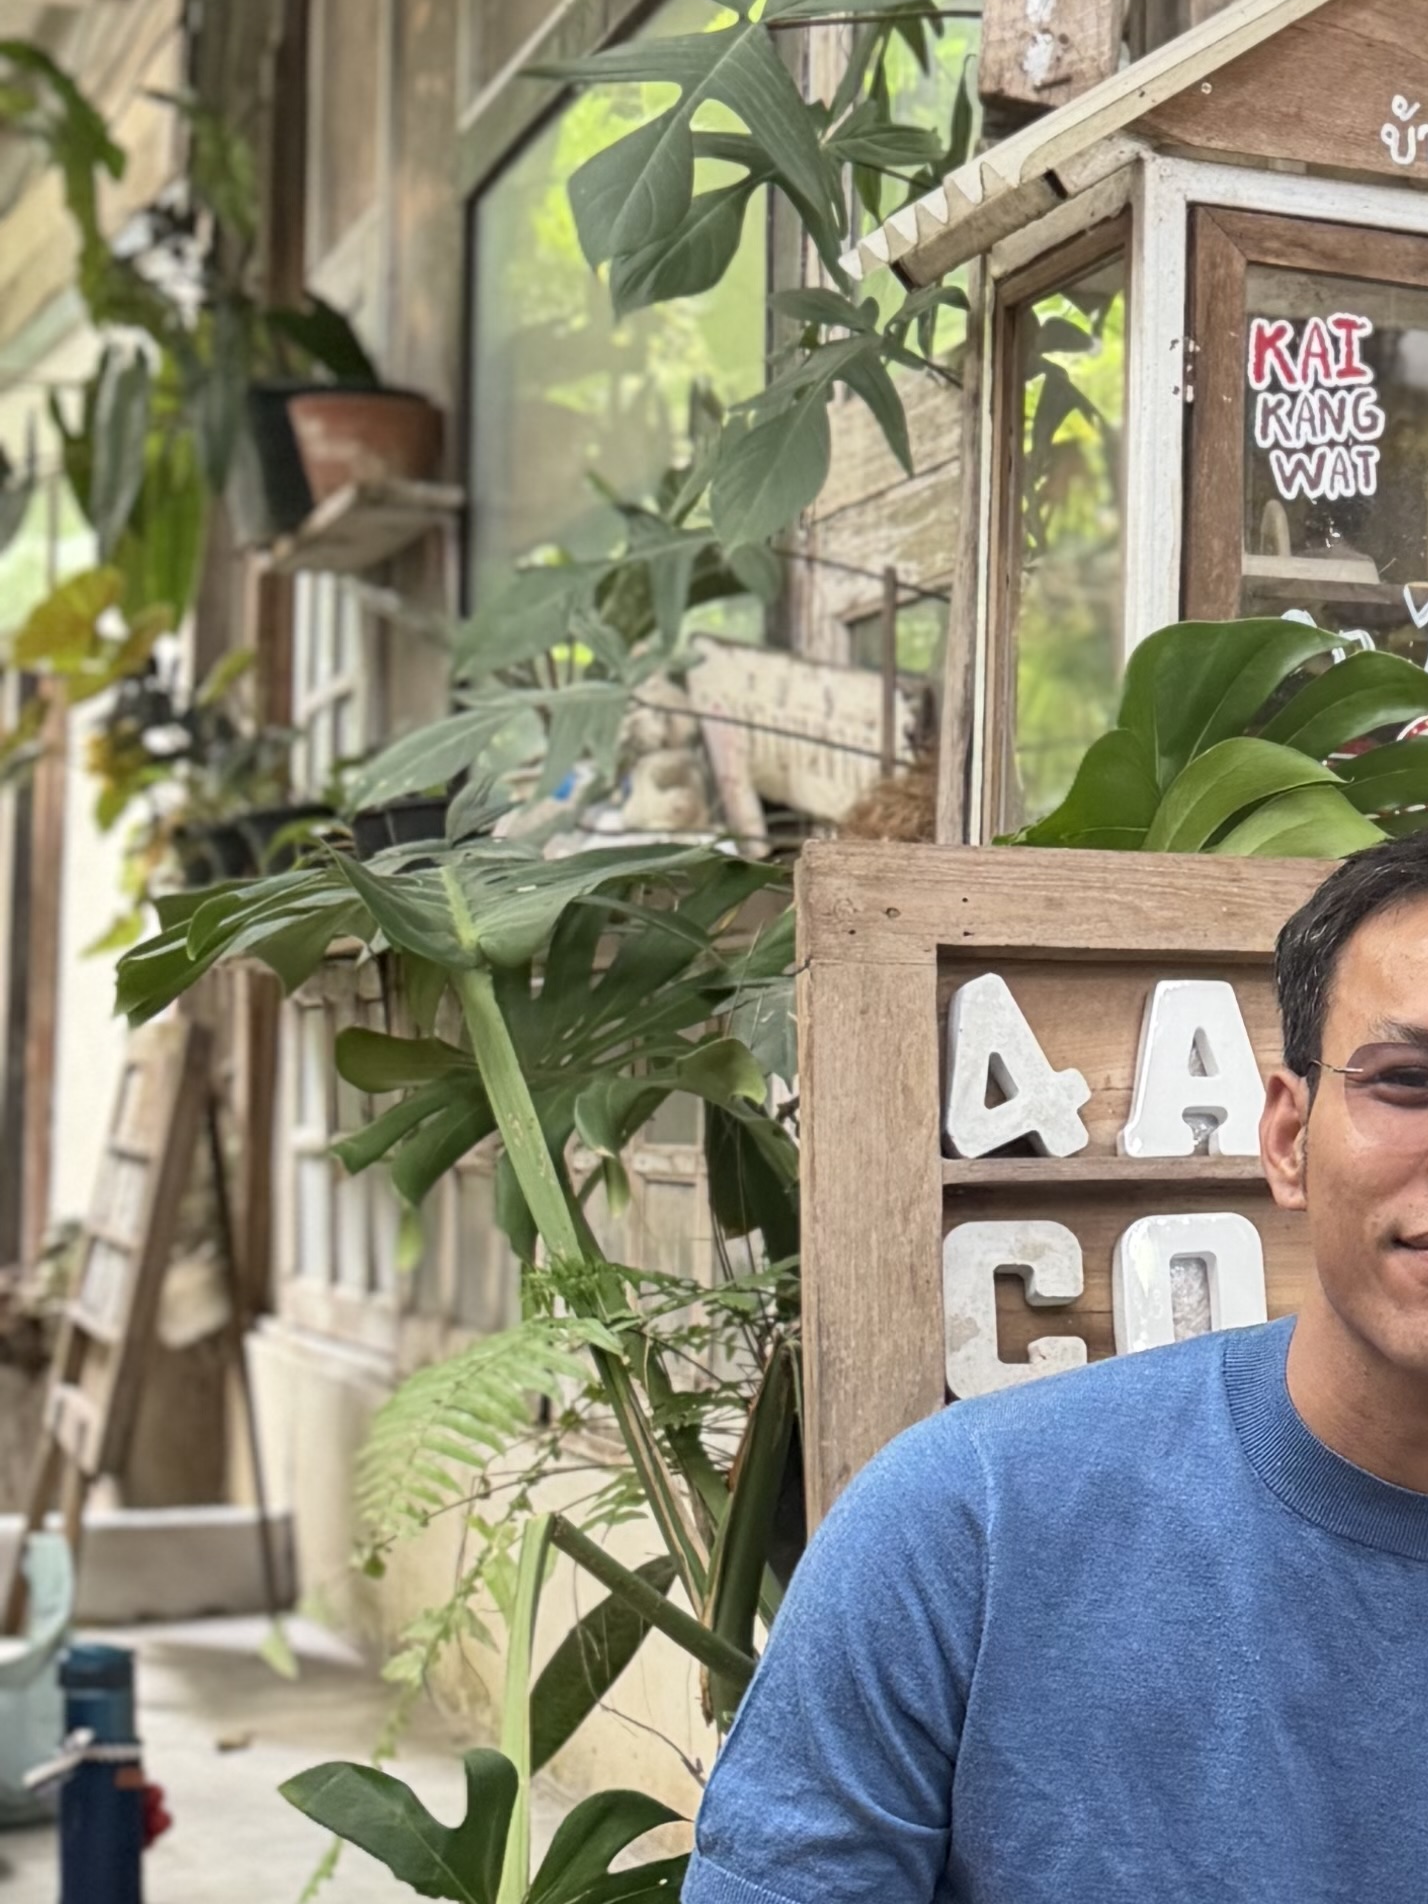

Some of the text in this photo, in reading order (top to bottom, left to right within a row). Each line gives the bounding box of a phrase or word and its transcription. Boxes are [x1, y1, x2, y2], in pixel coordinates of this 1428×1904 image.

[1251, 315, 1370, 387] KAI
[1258, 391, 1380, 444] KANG
[1273, 449, 1377, 494] WAT
[1117, 980, 1267, 1157] A
